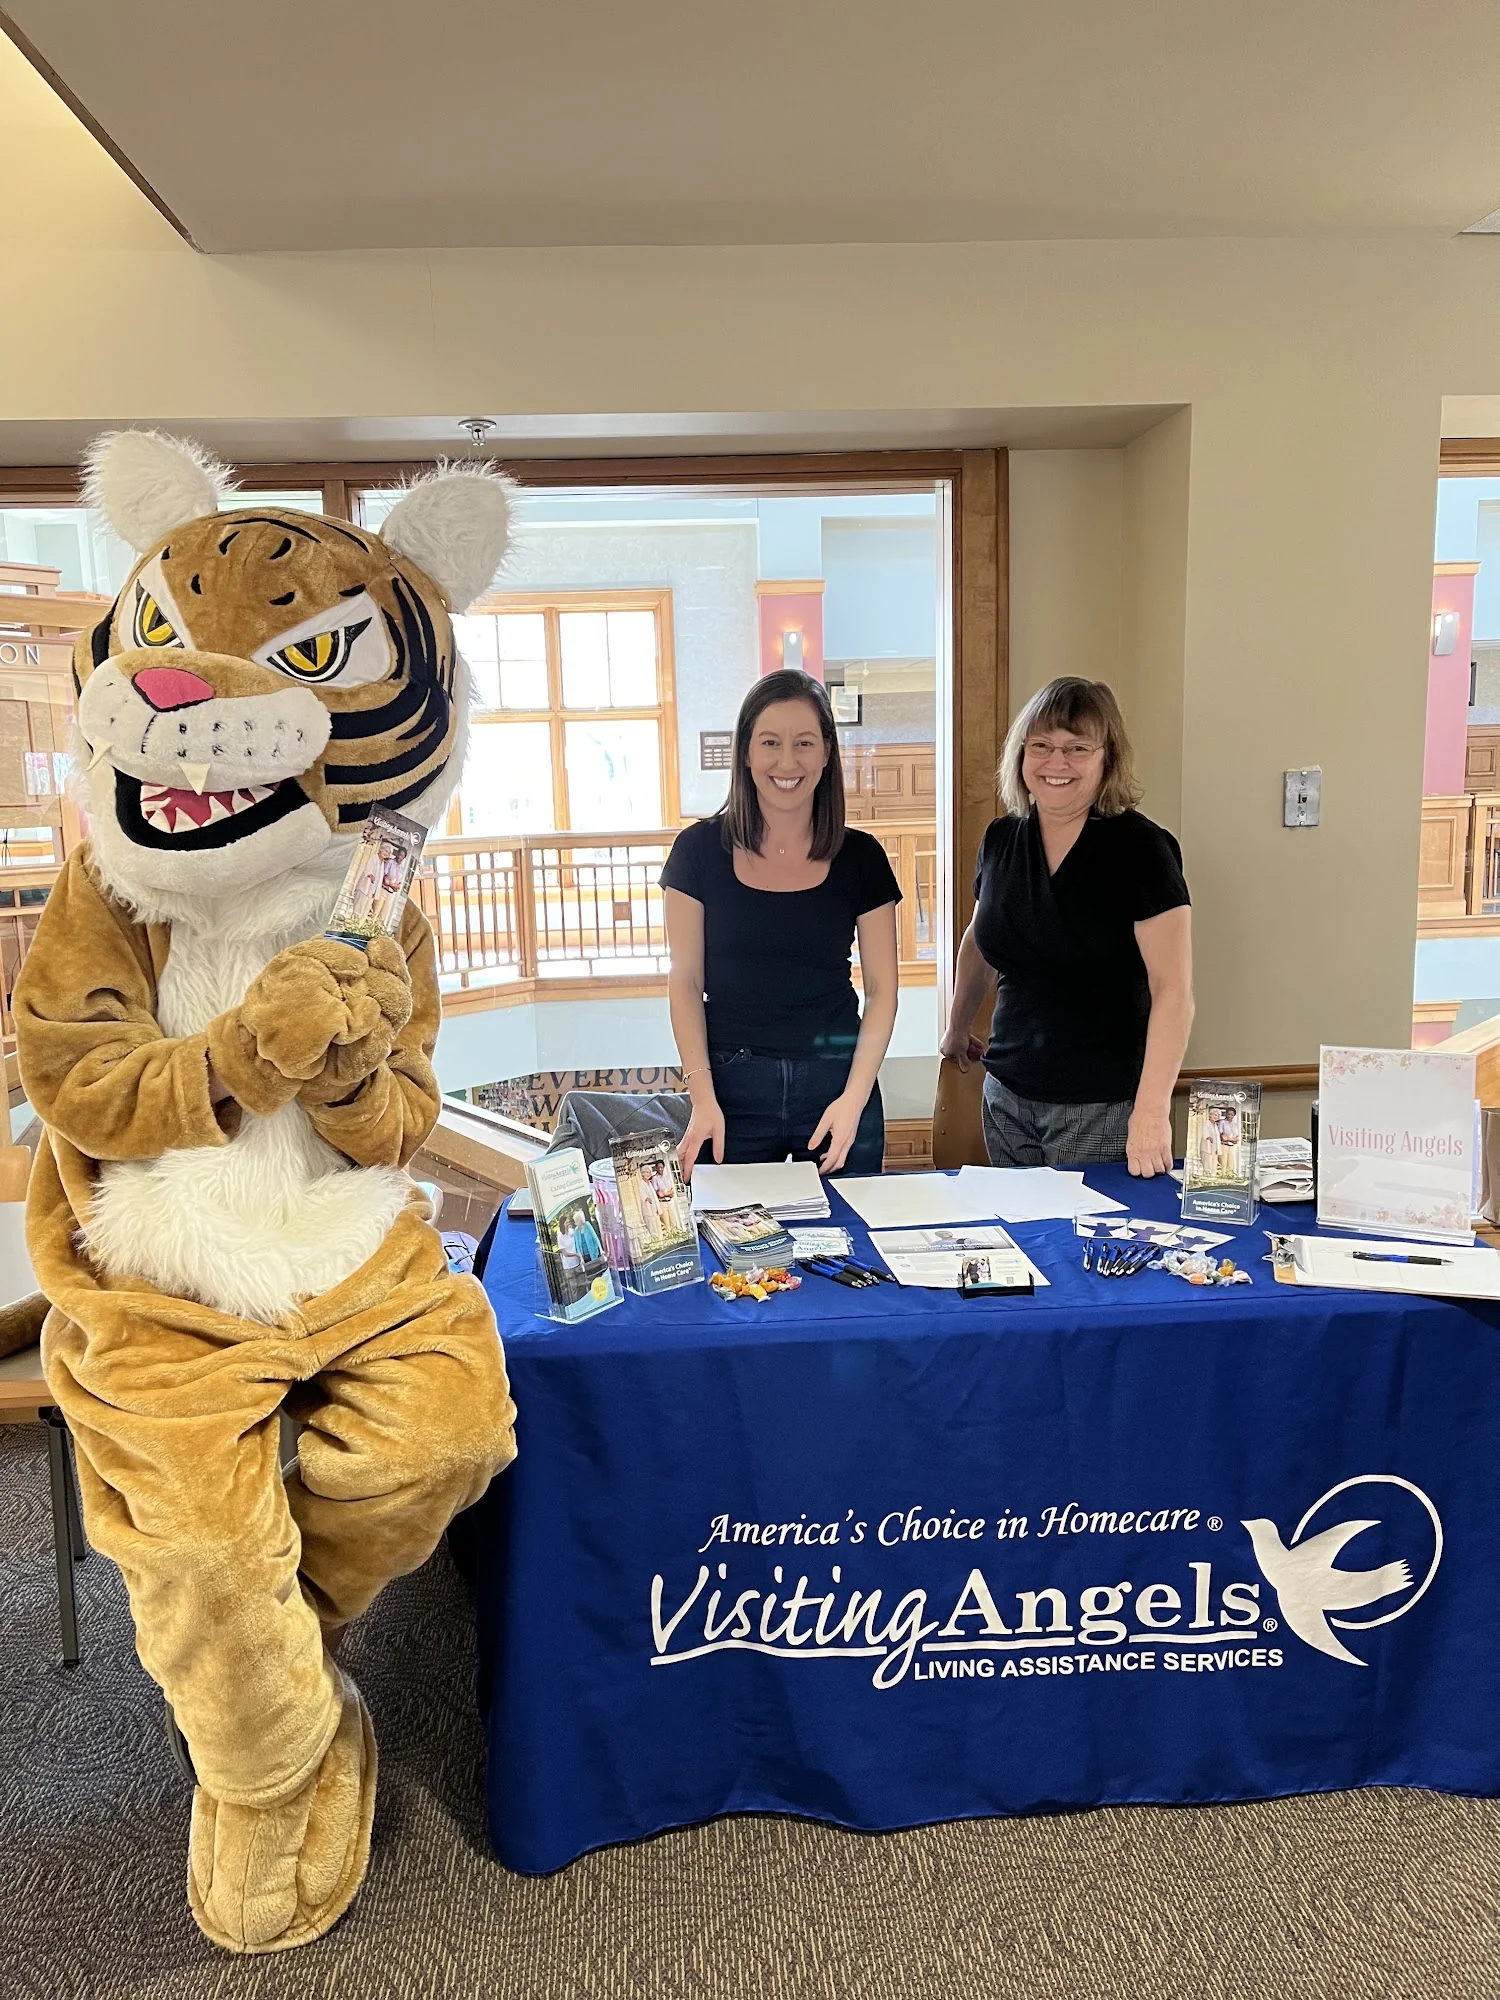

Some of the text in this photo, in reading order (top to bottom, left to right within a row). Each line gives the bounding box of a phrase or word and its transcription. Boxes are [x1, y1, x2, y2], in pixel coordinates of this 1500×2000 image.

[526, 1066, 686, 1091] EVERYON
[1328, 1124, 1396, 1154] Visiting
[1401, 1130, 1463, 1158] Angels
[1220, 1202, 1241, 1210] Choice
[650, 1261, 694, 1278] America's Choice
[660, 1272, 676, 1281] Home
[698, 1509, 867, 1552] America's
[878, 1506, 985, 1546] Choice
[997, 1509, 1028, 1539] in
[1037, 1503, 1200, 1537] Homecare
[651, 1563, 939, 1689] Visiting
[938, 1562, 1260, 1645] Angels
[915, 1649, 1283, 1680] LIVING ASSISTANCE SERVICES
